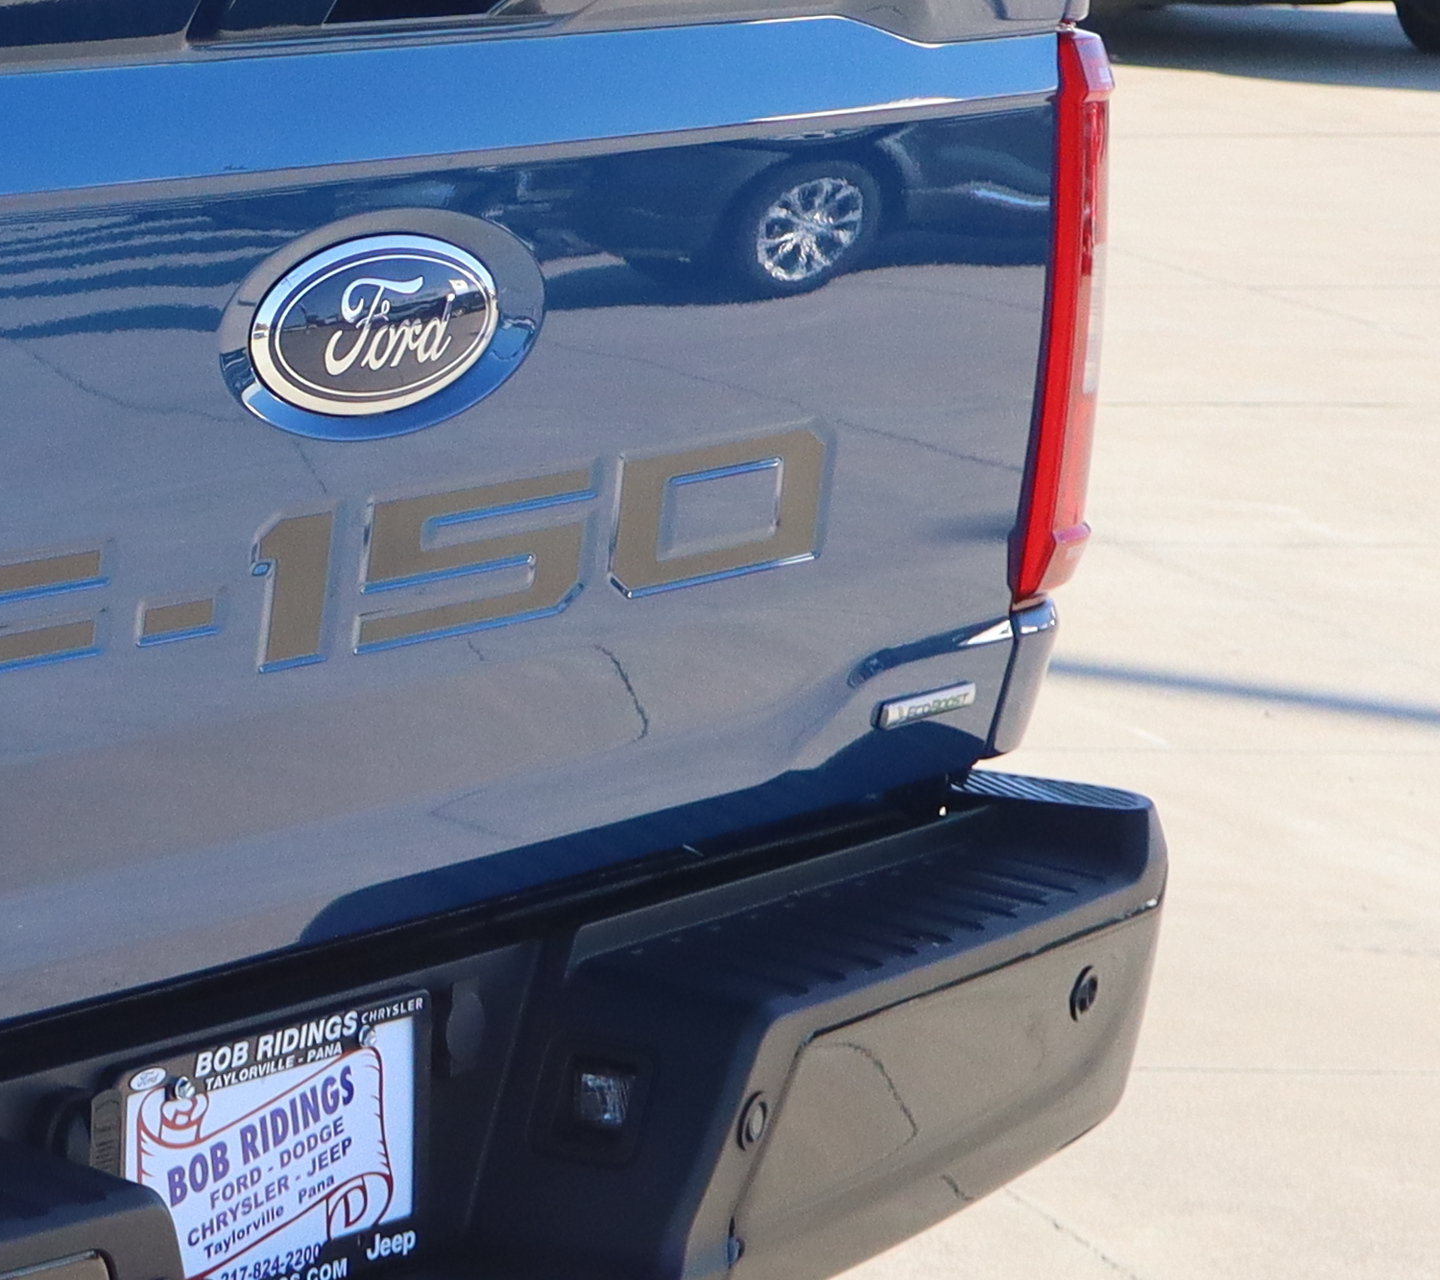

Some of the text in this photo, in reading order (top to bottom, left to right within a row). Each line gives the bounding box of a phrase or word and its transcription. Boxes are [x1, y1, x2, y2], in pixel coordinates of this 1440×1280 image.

[324, 276, 456, 376] Ford
[195, 1010, 358, 1078] BOB RIDINGS
[361, 997, 424, 1024] CHRYSLER
[204, 1056, 296, 1092] TAYLORVILLE
[307, 1042, 343, 1064] PANA
[166, 1065, 355, 1208] BOB RIDINGS
[209, 1169, 262, 1210] FORD
[280, 1116, 346, 1176] DODGE
[187, 1178, 290, 1247] CHRYSLER
[307, 1137, 353, 1186] JEEP
[204, 1174, 336, 1261] Taylorville Pana
[367, 1232, 417, 1262] Jeep
